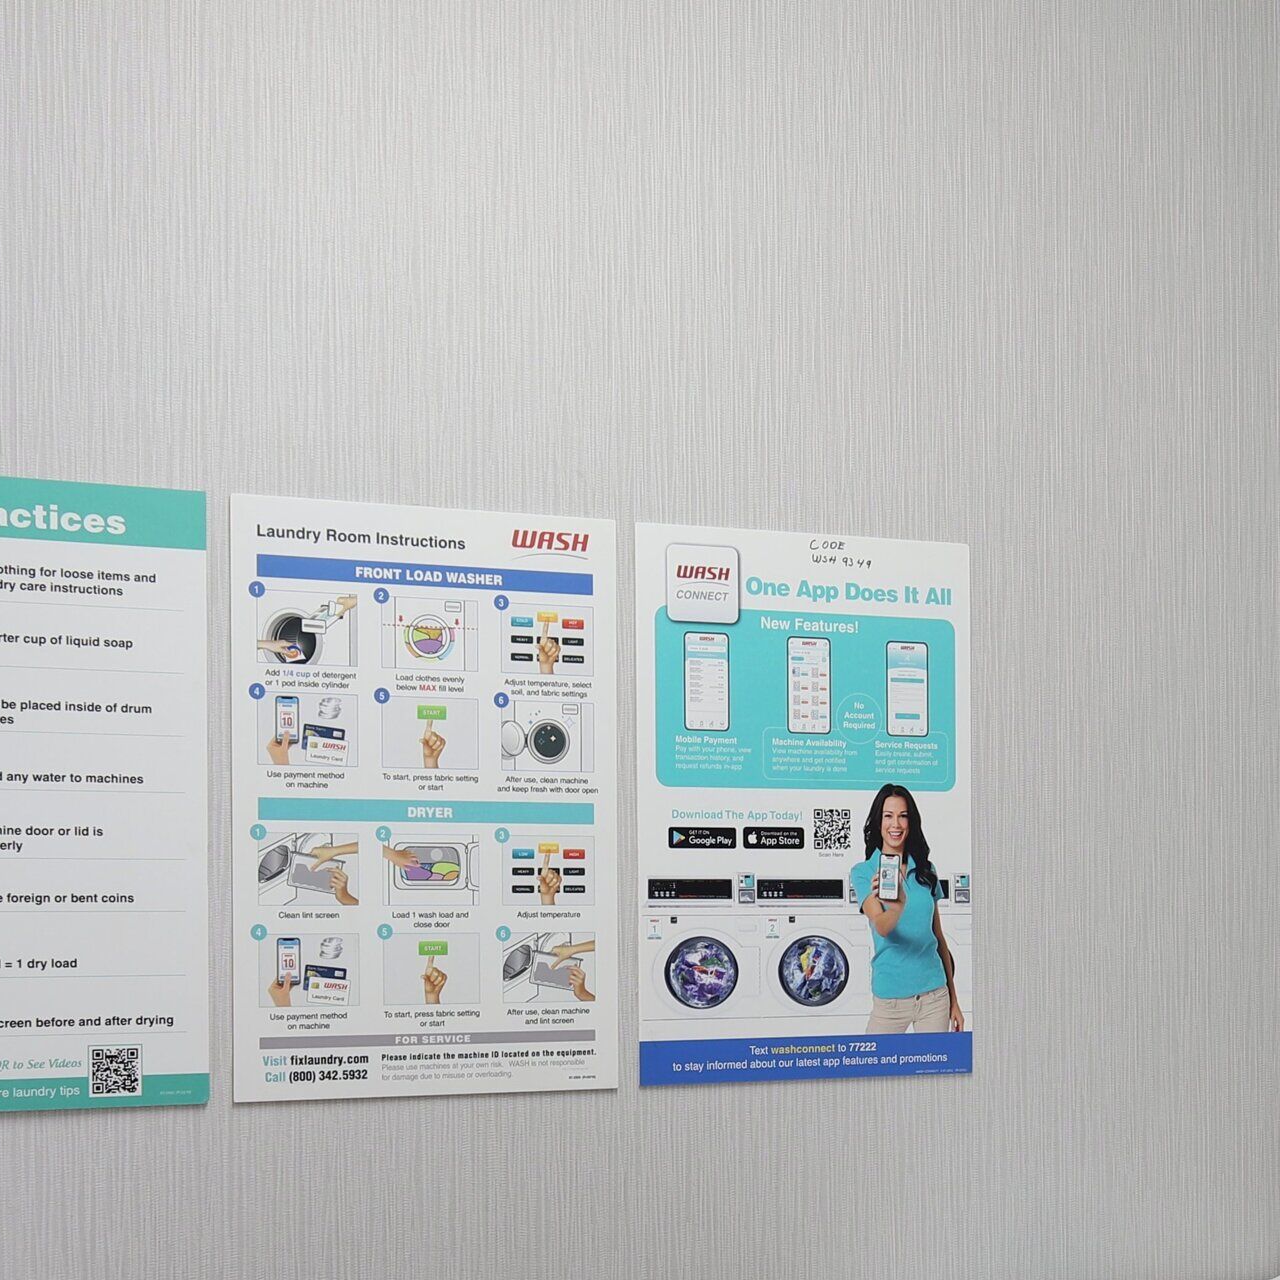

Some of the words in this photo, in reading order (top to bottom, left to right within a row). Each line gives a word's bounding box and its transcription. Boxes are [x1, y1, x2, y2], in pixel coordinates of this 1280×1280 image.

[257, 524, 321, 544] Laundry
[326, 528, 371, 544] Room
[376, 532, 465, 550] Instructions
[511, 530, 589, 552] WASH
[809, 539, 845, 550] CODE
[39, 566, 57, 577] for
[60, 568, 94, 580] loose
[97, 570, 130, 582] items
[134, 573, 156, 583] and
[355, 566, 402, 580] FRONT
[406, 569, 442, 582] LOAD
[445, 571, 502, 586] WASHER
[676, 565, 730, 581] WASH
[19, 582, 46, 592] care
[50, 582, 123, 596] instructions
[676, 589, 729, 601] CONNECT
[745, 576, 791, 597] One
[796, 579, 840, 602] App
[845, 581, 898, 603] Does
[904, 585, 919, 604] It
[924, 587, 952, 606] All
[761, 616, 790, 630] New
[795, 618, 858, 634] Features!
[23, 635, 46, 646] cup
[50, 635, 62, 645] of
[66, 635, 100, 648] liquid
[103, 639, 133, 650] soap
[1, 699, 16, 709] be
[20, 700, 61, 712] placed
[65, 703, 102, 714] inside
[105, 705, 117, 714] of
[120, 703, 152, 713] drum
[675, 735, 702, 745] Mobile
[702, 735, 737, 747] Payment
[772, 738, 804, 749] Machine
[804, 738, 848, 750] Availability
[875, 740, 904, 750] Service
[904, 741, 938, 751] Requests
[6, 773, 29, 784] any
[32, 773, 66, 782] water
[69, 773, 82, 783] to
[85, 774, 144, 784] machines
[407, 806, 453, 818] DRYER
[671, 809, 724, 819] Download
[724, 809, 744, 819] The
[747, 810, 768, 822] App
[769, 810, 802, 823] Today!
[25, 826, 54, 836] door
[57, 828, 71, 836] or
[74, 826, 89, 836] lid
[93, 826, 103, 836] is
[688, 835, 716, 846] Google
[716, 835, 732, 846] Play
[760, 836, 777, 846] App
[778, 836, 800, 845] Store
[6, 892, 50, 905] foreign
[54, 895, 67, 903] or
[71, 893, 98, 903] bent
[101, 893, 134, 903] coins
[278, 911, 300, 919] Clean
[392, 911, 410, 919] Load
[36, 1017, 75, 1027] before
[78, 1016, 101, 1026] and
[104, 1015, 132, 1026] after
[135, 1015, 174, 1027] drying
[395, 1035, 418, 1044] FOR
[421, 1034, 471, 1044] SERVICE
[749, 1045, 768, 1055] Text
[770, 1043, 835, 1054] washconnect
[837, 1043, 847, 1052] to
[848, 1042, 877, 1052] 77222
[12, 1061, 24, 1070] to
[26, 1059, 45, 1069] See
[48, 1057, 82, 1068] Videos
[263, 1055, 287, 1066] Visit
[290, 1054, 369, 1066] fixlaundry.com
[672, 1062, 682, 1071] to
[684, 1062, 704, 1073] stay
[706, 1059, 748, 1070] informed
[749, 1059, 776, 1069] about
[778, 1059, 794, 1068] our
[796, 1057, 821, 1067] latest
[822, 1058, 840, 1068] app
[842, 1055, 878, 1065] features
[880, 1054, 898, 1064] and
[899, 1053, 948, 1065] promotions
[265, 1072, 286, 1083] Call
[289, 1070, 316, 1084] (800)
[318, 1069, 368, 1081] 342.5932
[13, 1086, 56, 1099] laundry
[59, 1085, 80, 1097] tips
